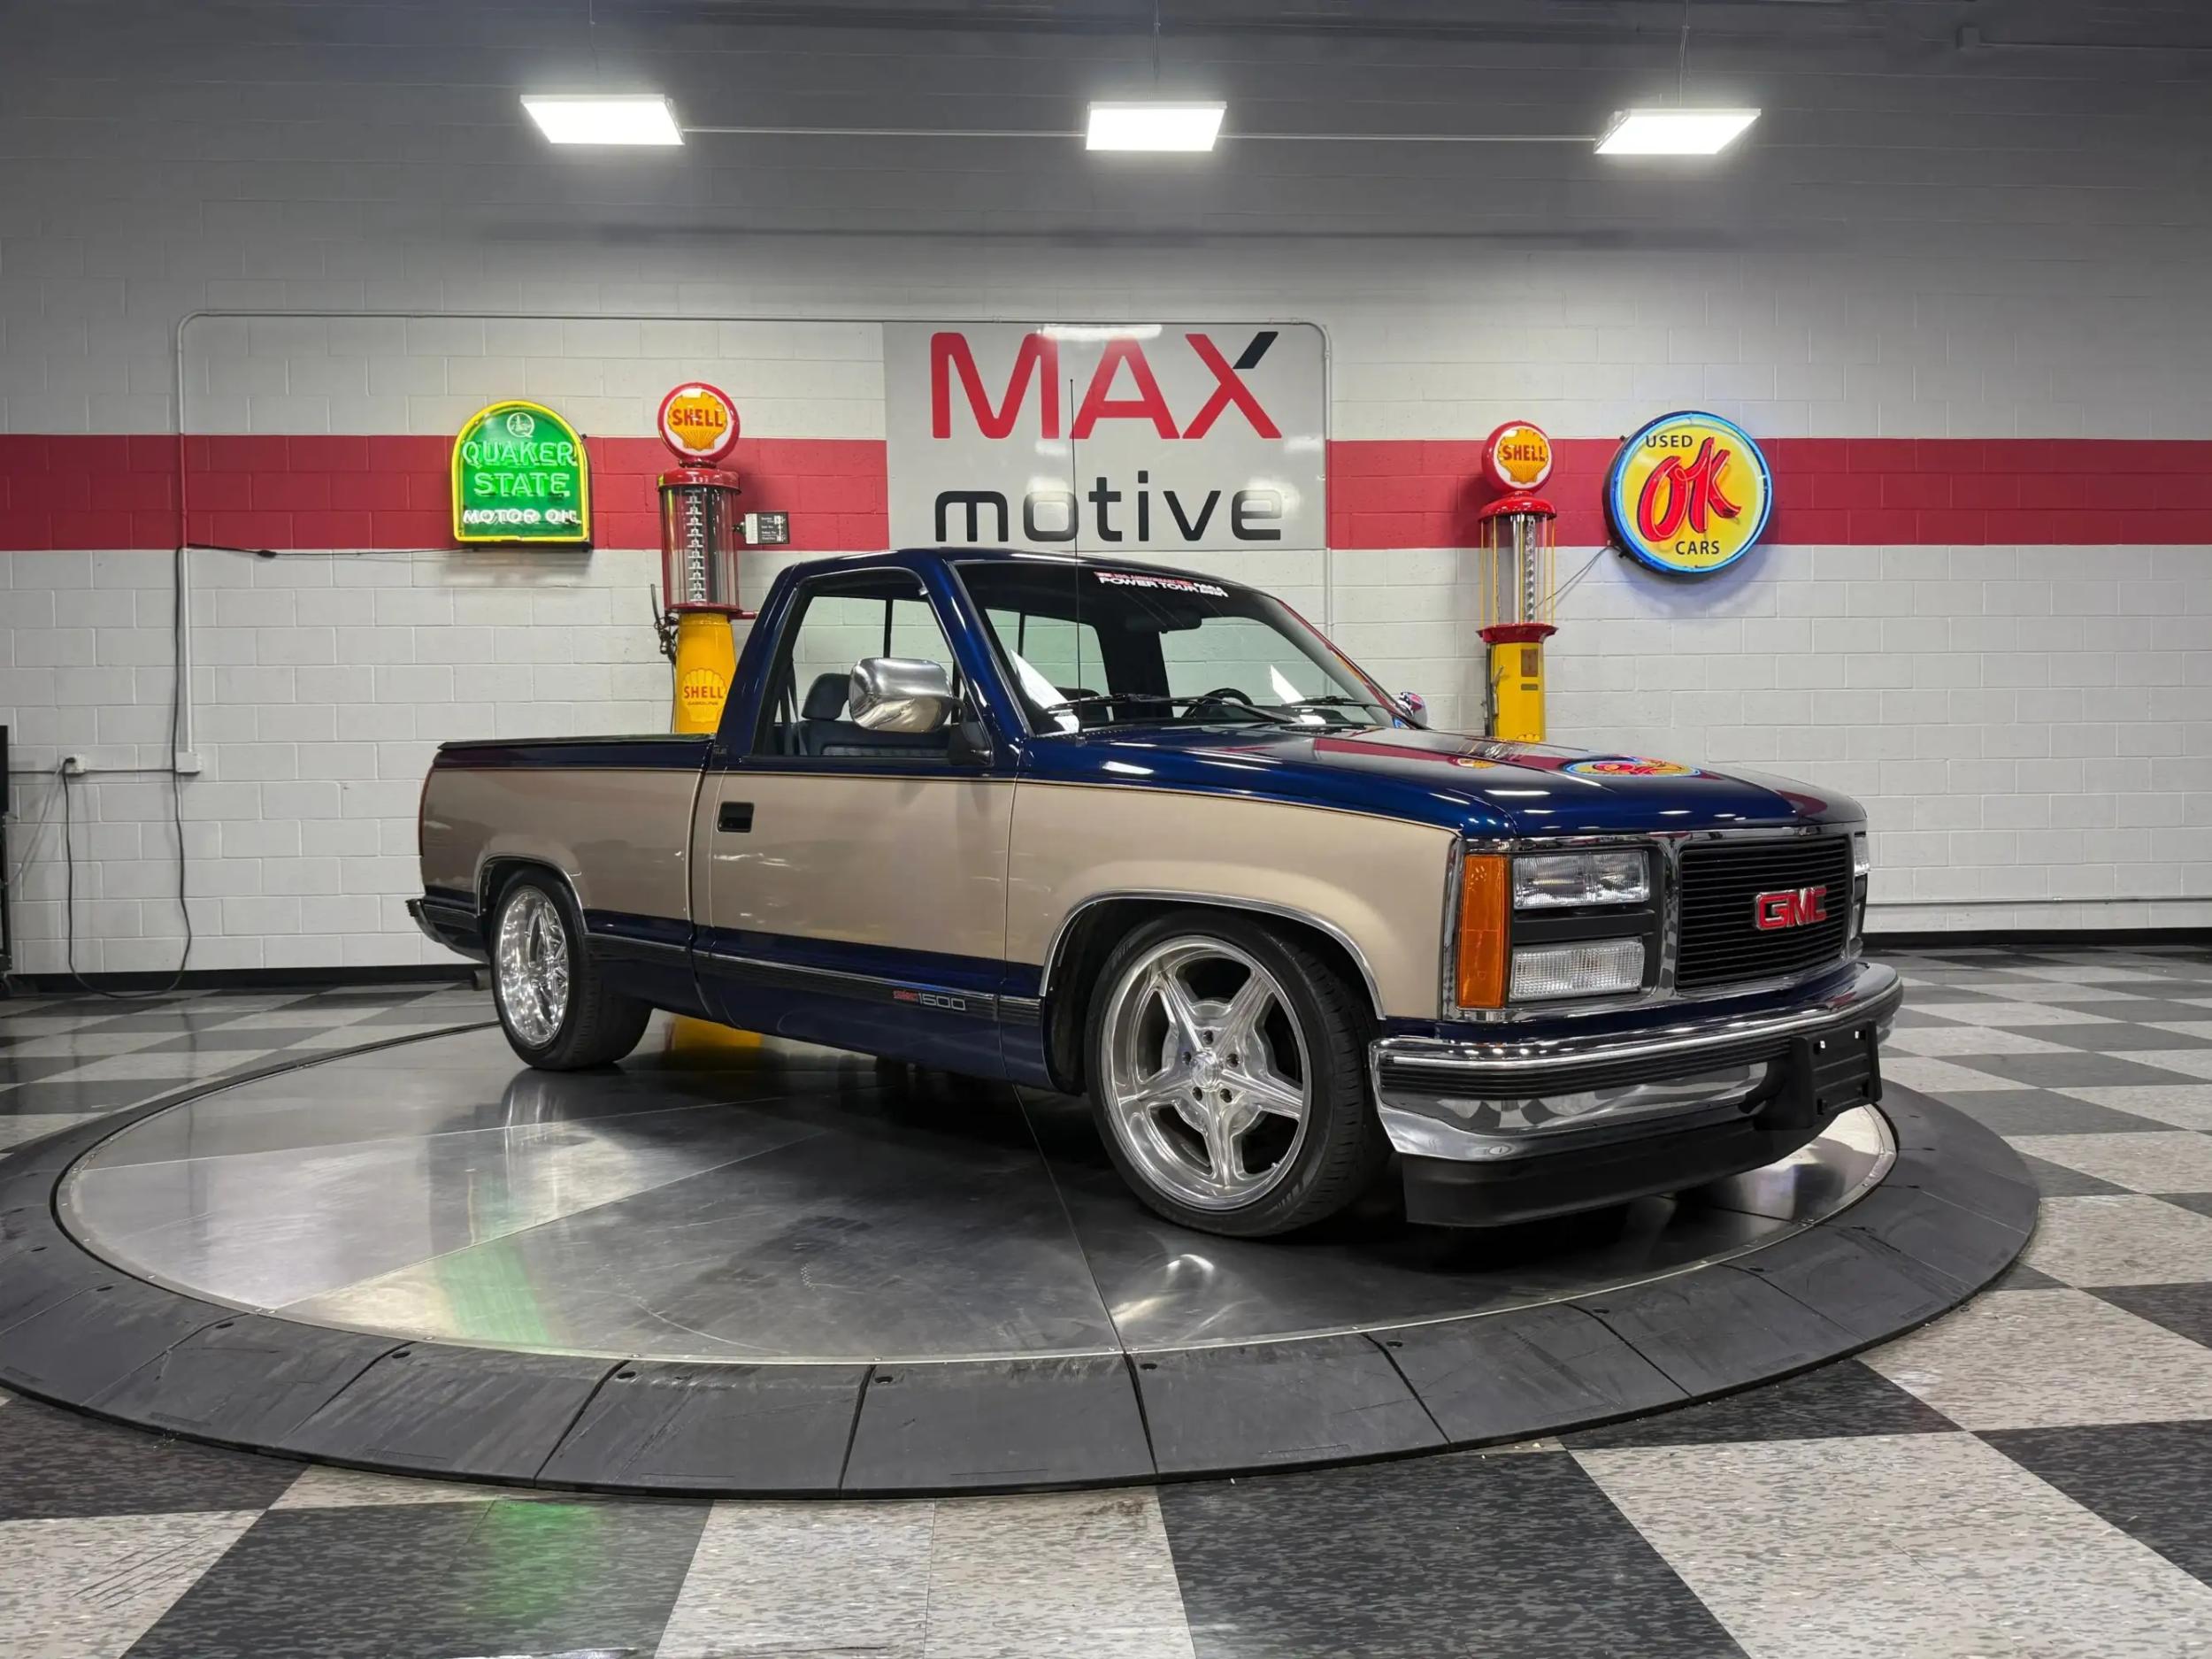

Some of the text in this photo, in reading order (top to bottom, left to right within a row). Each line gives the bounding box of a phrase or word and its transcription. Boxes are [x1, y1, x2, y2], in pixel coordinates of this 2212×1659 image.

[930, 331, 1282, 439] MAX
[672, 408, 724, 427] SHELL
[1646, 434, 1694, 449] USED
[462, 441, 578, 469] QUAKER
[1502, 443, 1546, 463] SHELL
[473, 472, 571, 497] STATE
[1637, 436, 1741, 542] OK
[934, 470, 1282, 542] motive
[463, 509, 581, 525] MOTOR OIL
[1675, 541, 1720, 556] CARS
[1098, 577, 1159, 588] POWER
[1157, 582, 1200, 593] TOUR
[683, 686, 724, 699] SHELL
[1755, 885, 1827, 931] GMC
[918, 993, 966, 1011] 1500
